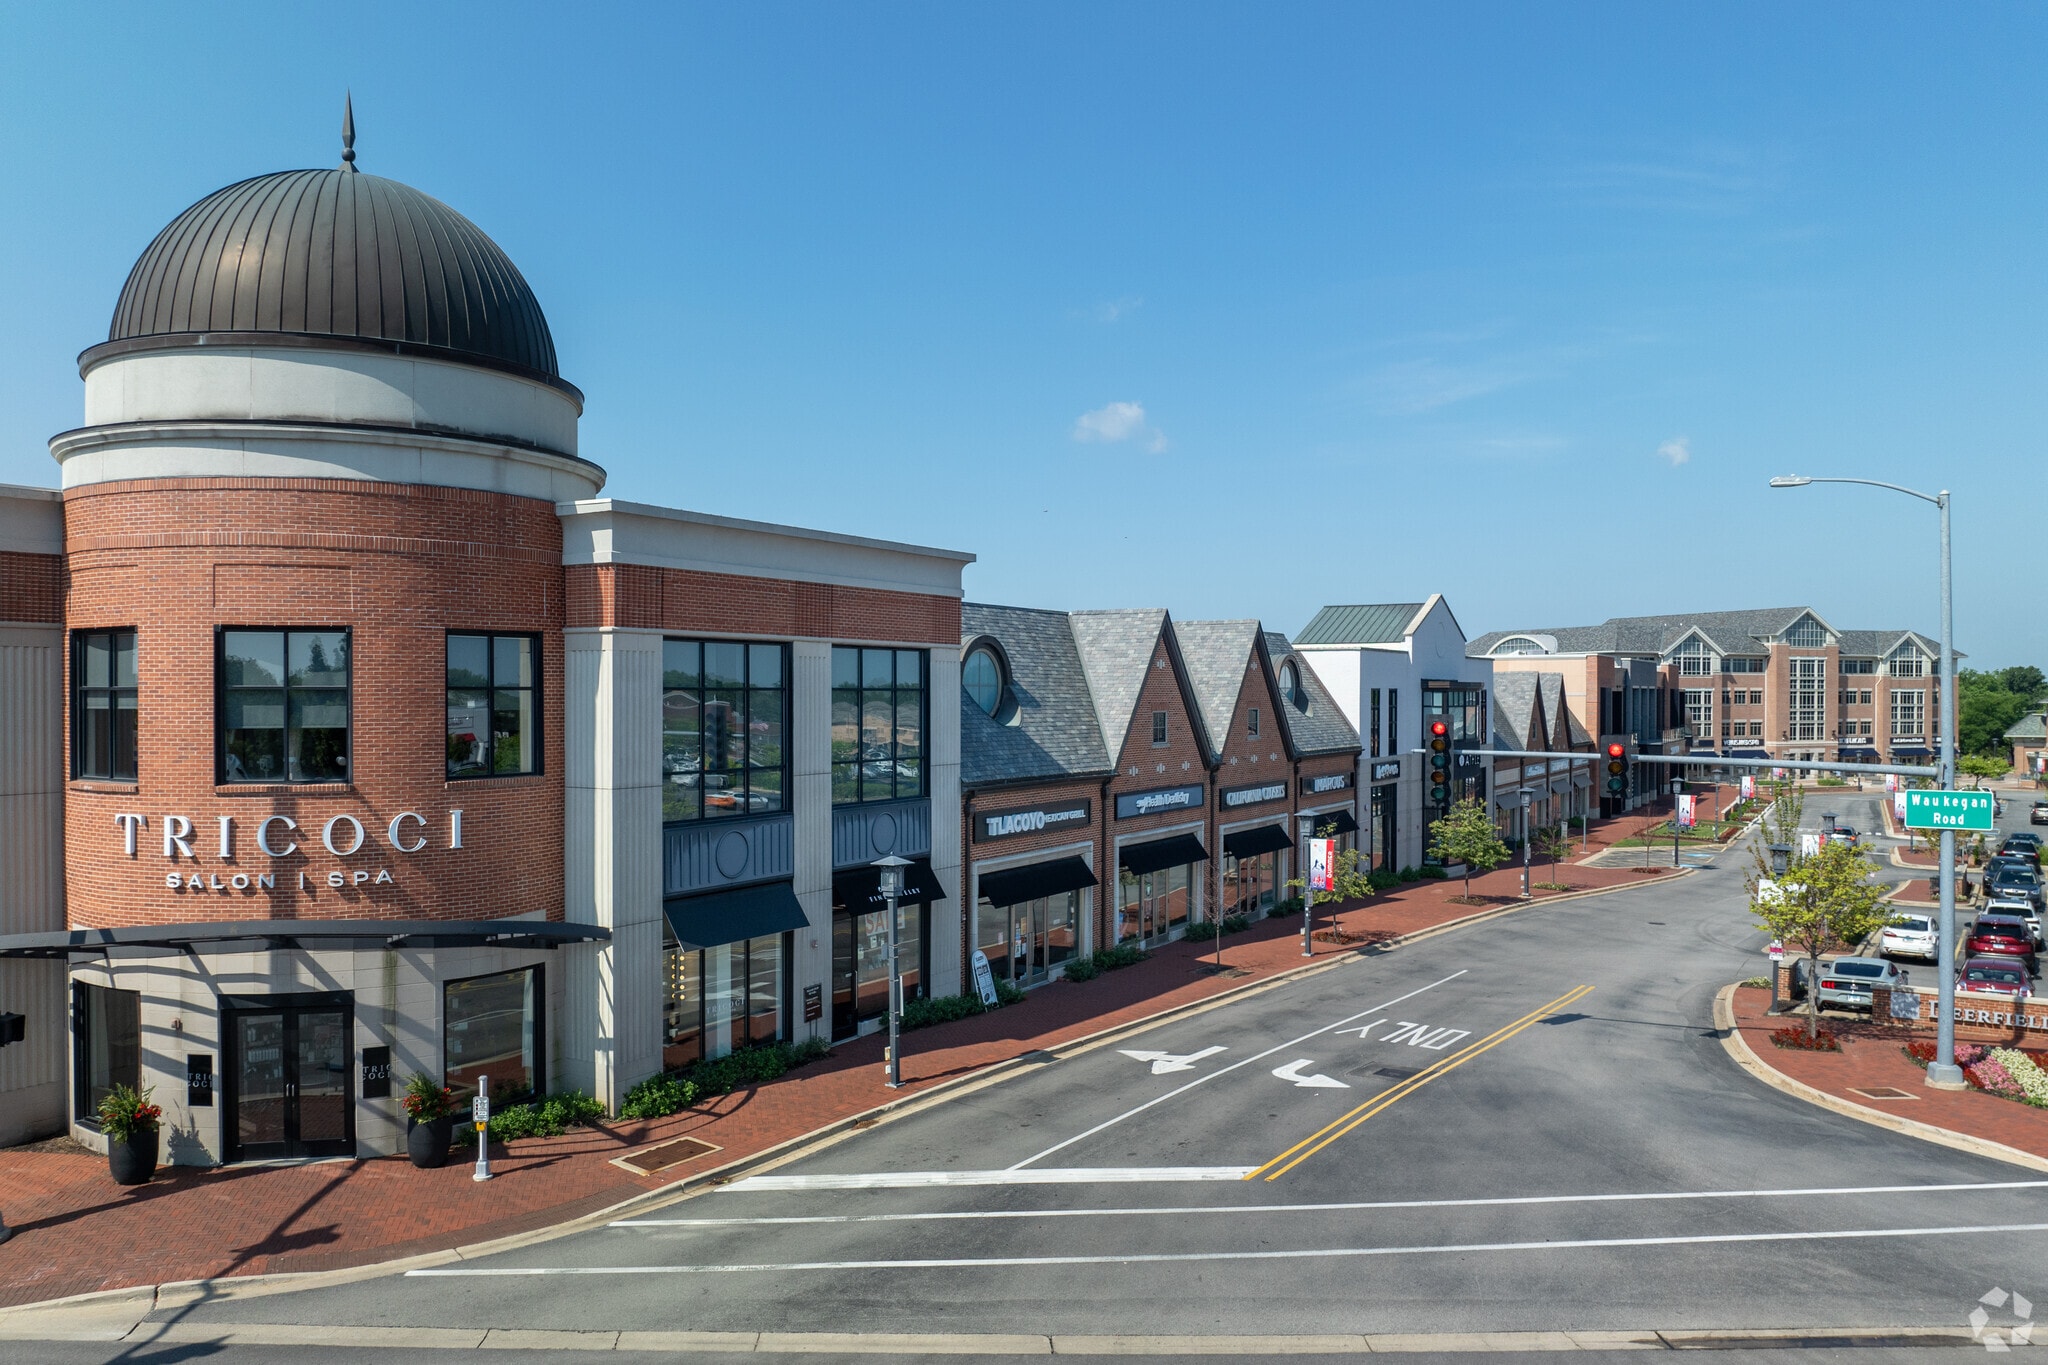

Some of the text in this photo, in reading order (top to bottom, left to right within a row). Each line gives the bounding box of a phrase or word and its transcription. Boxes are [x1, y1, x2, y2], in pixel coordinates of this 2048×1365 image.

[1911, 793, 1988, 811] Waukegan
[986, 811, 1045, 836] TLACOYO
[1069, 809, 1086, 819] GRILL
[1933, 812, 1965, 825] Road
[114, 809, 464, 857] TRICOCI
[165, 871, 276, 891] SALON
[327, 869, 394, 889] SPA
[1334, 1018, 1472, 1050] ONLY
